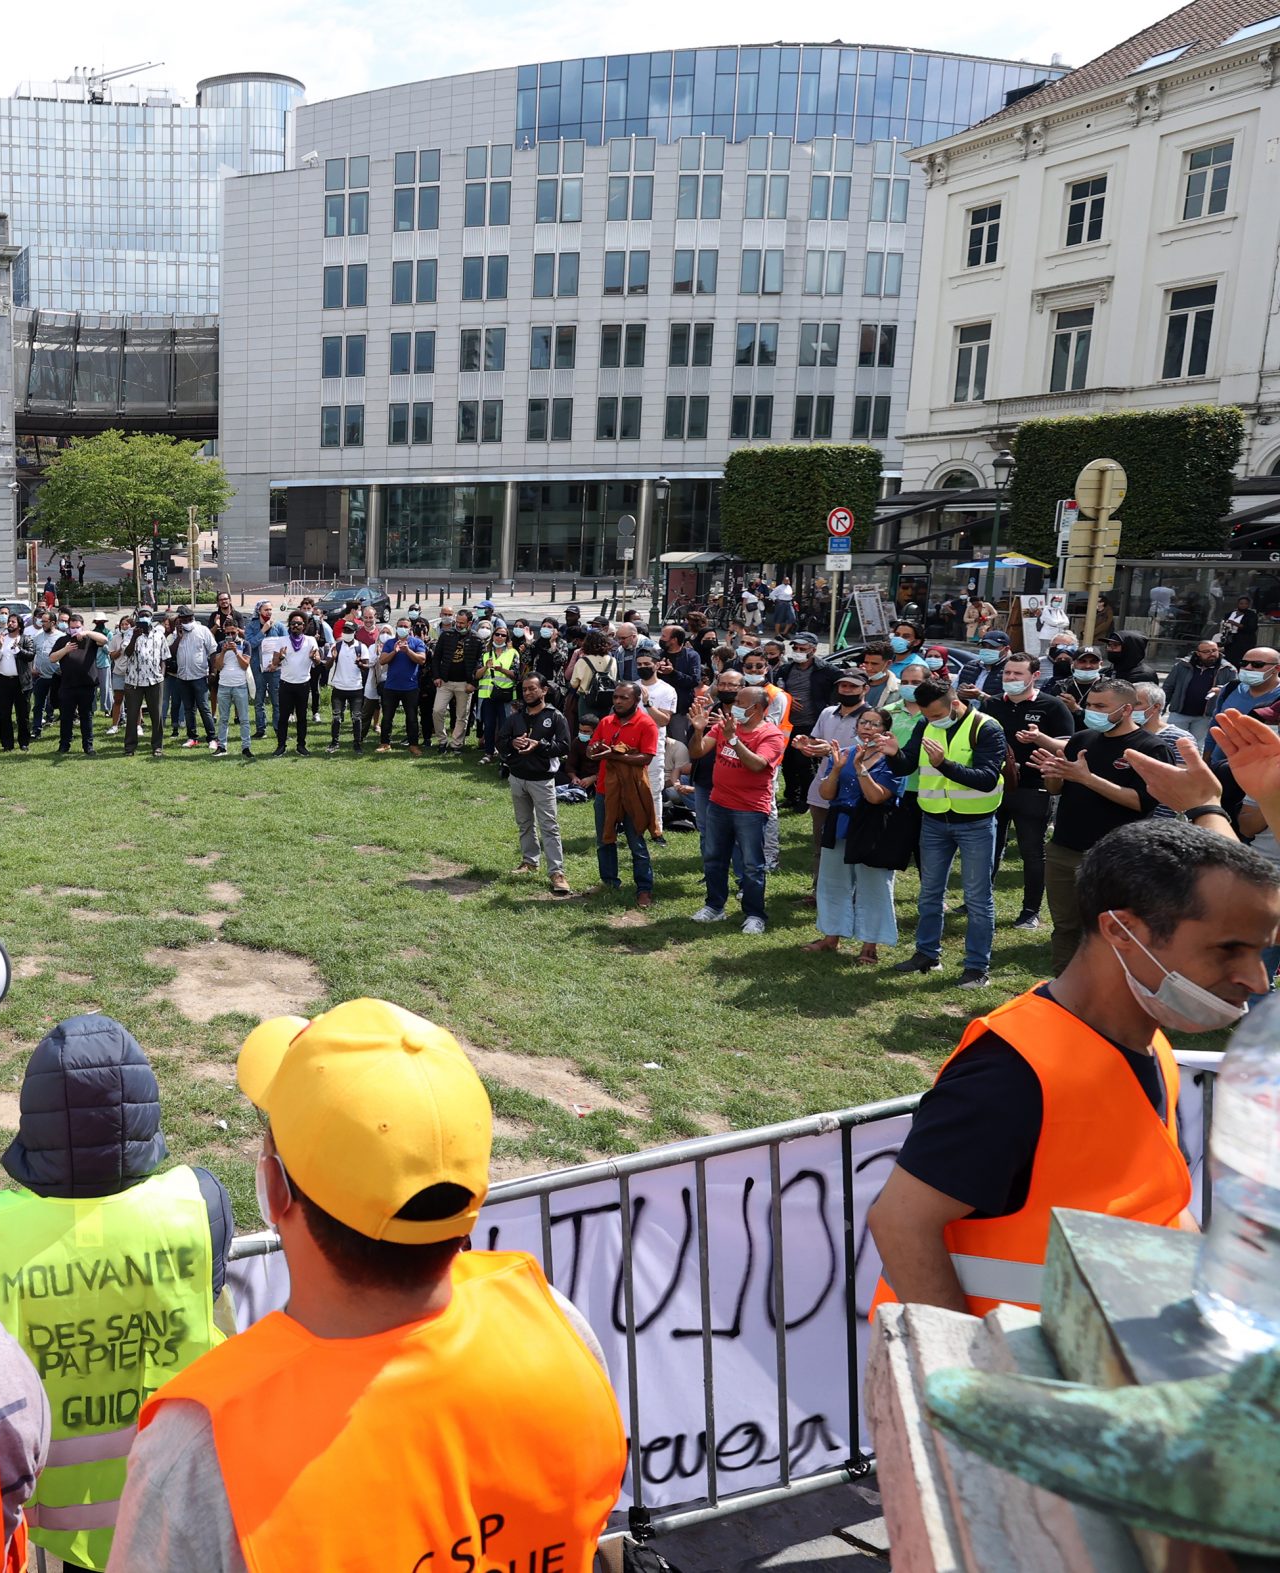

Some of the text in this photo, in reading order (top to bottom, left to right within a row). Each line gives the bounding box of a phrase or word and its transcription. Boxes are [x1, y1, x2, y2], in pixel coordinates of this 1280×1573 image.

[1024, 713, 1041, 721] EA7
[1, 1246, 196, 1304] MOUVANCE
[27, 1307, 189, 1350] DES SANS
[38, 1336, 180, 1380] PAPIERS
